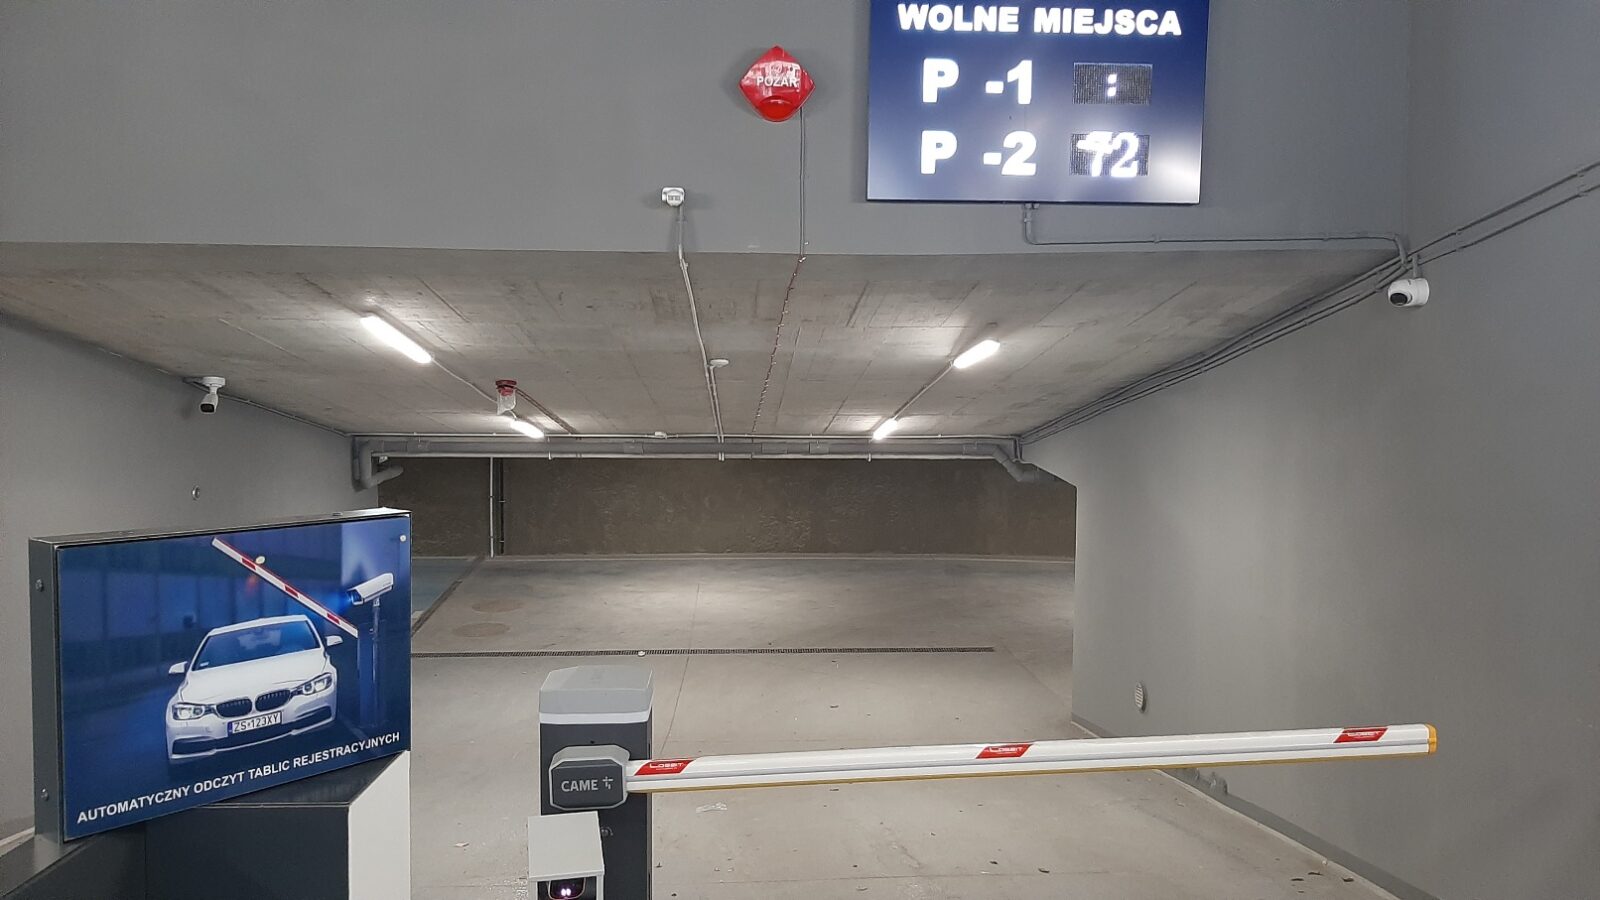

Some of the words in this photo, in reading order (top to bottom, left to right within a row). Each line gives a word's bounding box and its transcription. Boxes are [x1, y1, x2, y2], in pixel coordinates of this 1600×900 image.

[898, 3, 1019, 32] WOLNE
[1034, 8, 1181, 36] MIEJSCA
[922, 58, 959, 103] P
[985, 60, 1032, 104] -1
[921, 130, 957, 175] P
[983, 131, 1037, 176] -2
[77, 785, 190, 824] AUTOMATYCZNY
[193, 771, 245, 794] ODCZYT
[248, 760, 290, 780] TABLIC
[293, 732, 400, 768] REJESTRACYJNYCH
[561, 779, 598, 792] CAME
